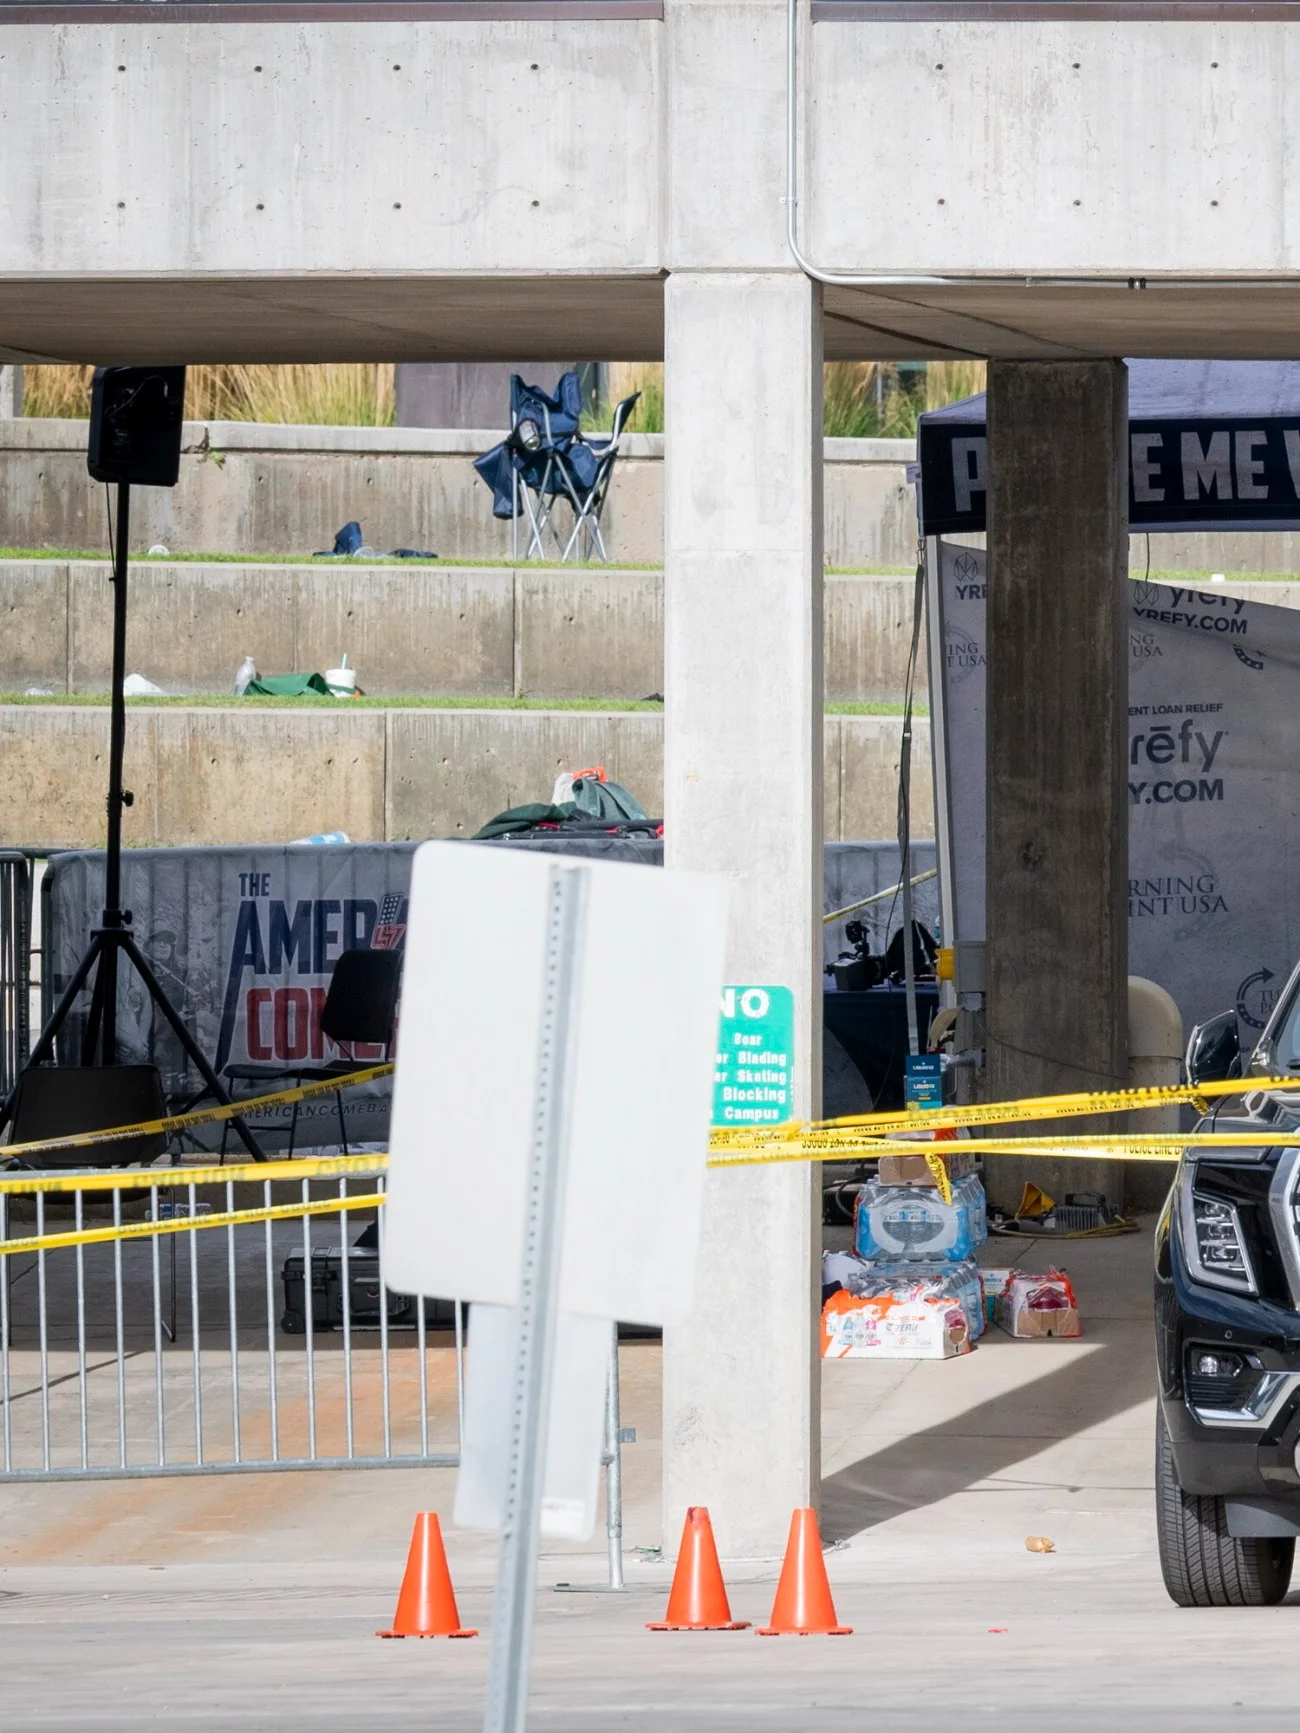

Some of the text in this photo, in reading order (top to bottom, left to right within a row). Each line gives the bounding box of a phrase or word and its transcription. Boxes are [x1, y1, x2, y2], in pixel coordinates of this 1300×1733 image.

[1180, 430, 1269, 501] ME
[1133, 607, 1248, 634] YREFY.COM
[1132, 646, 1163, 658] USA
[1152, 704, 1183, 716] LOAN
[1185, 703, 1224, 714] RELIEF
[238, 872, 271, 897] THE
[1181, 894, 1230, 915] USA
[737, 1051, 787, 1067] Blading
[737, 1069, 787, 1085] Skating
[723, 1087, 786, 1104] Blocking
[724, 1106, 780, 1122] Campus
